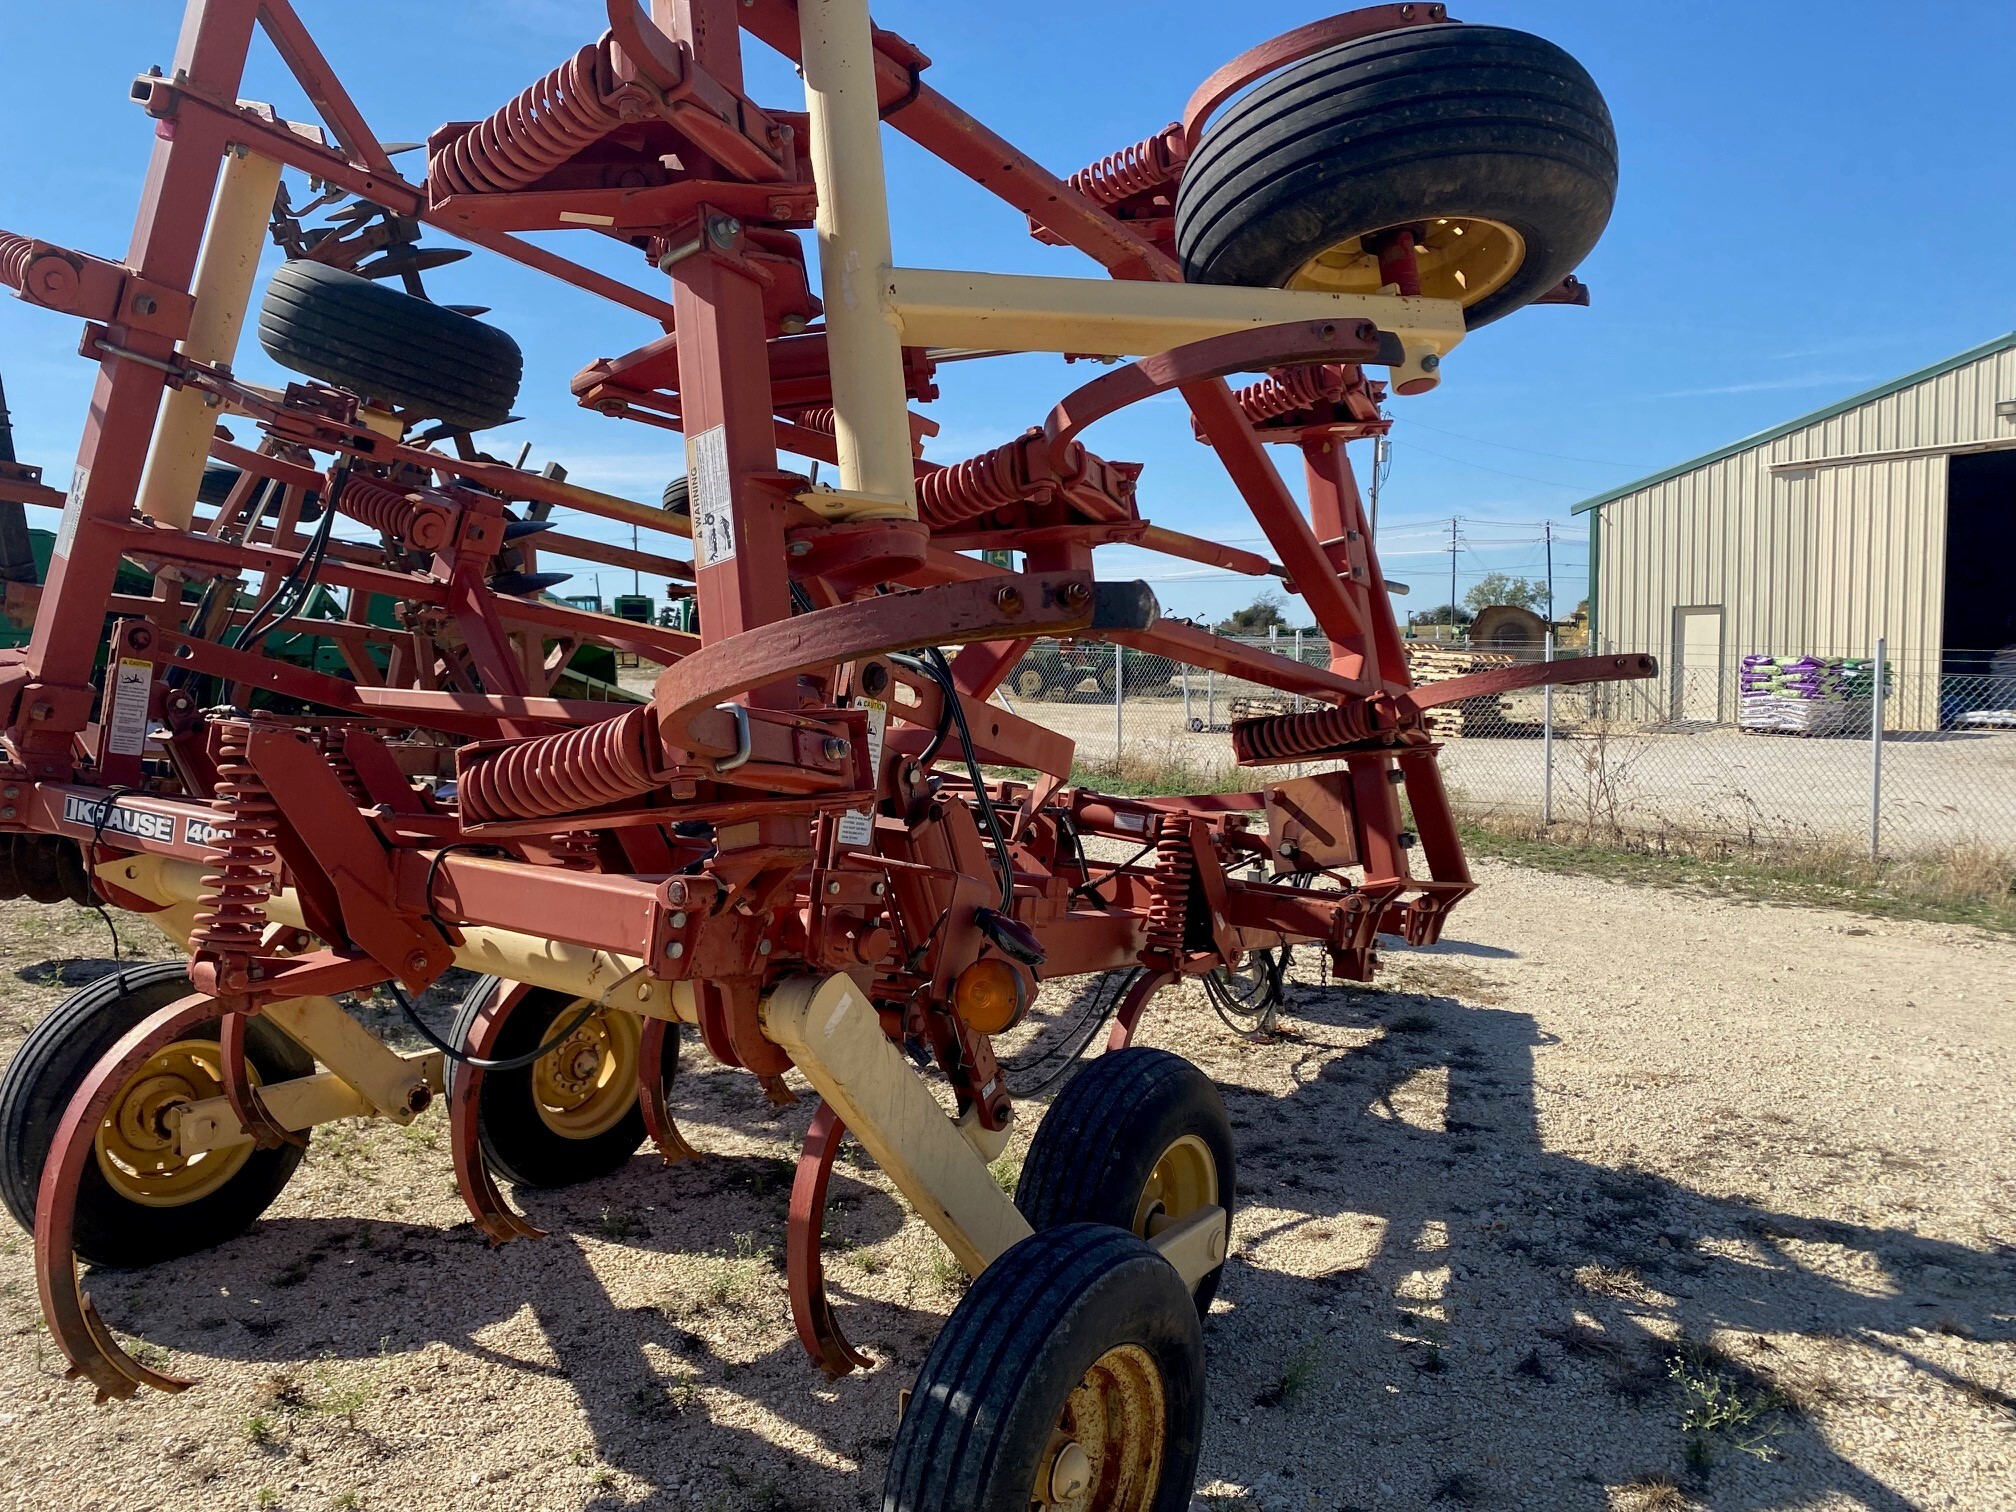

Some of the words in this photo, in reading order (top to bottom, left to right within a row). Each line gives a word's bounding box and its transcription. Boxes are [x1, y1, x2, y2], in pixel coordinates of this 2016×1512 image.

[691, 467, 702, 528] WARNING
[129, 660, 152, 668] CAUTION
[863, 700, 886, 711] CAUTION
